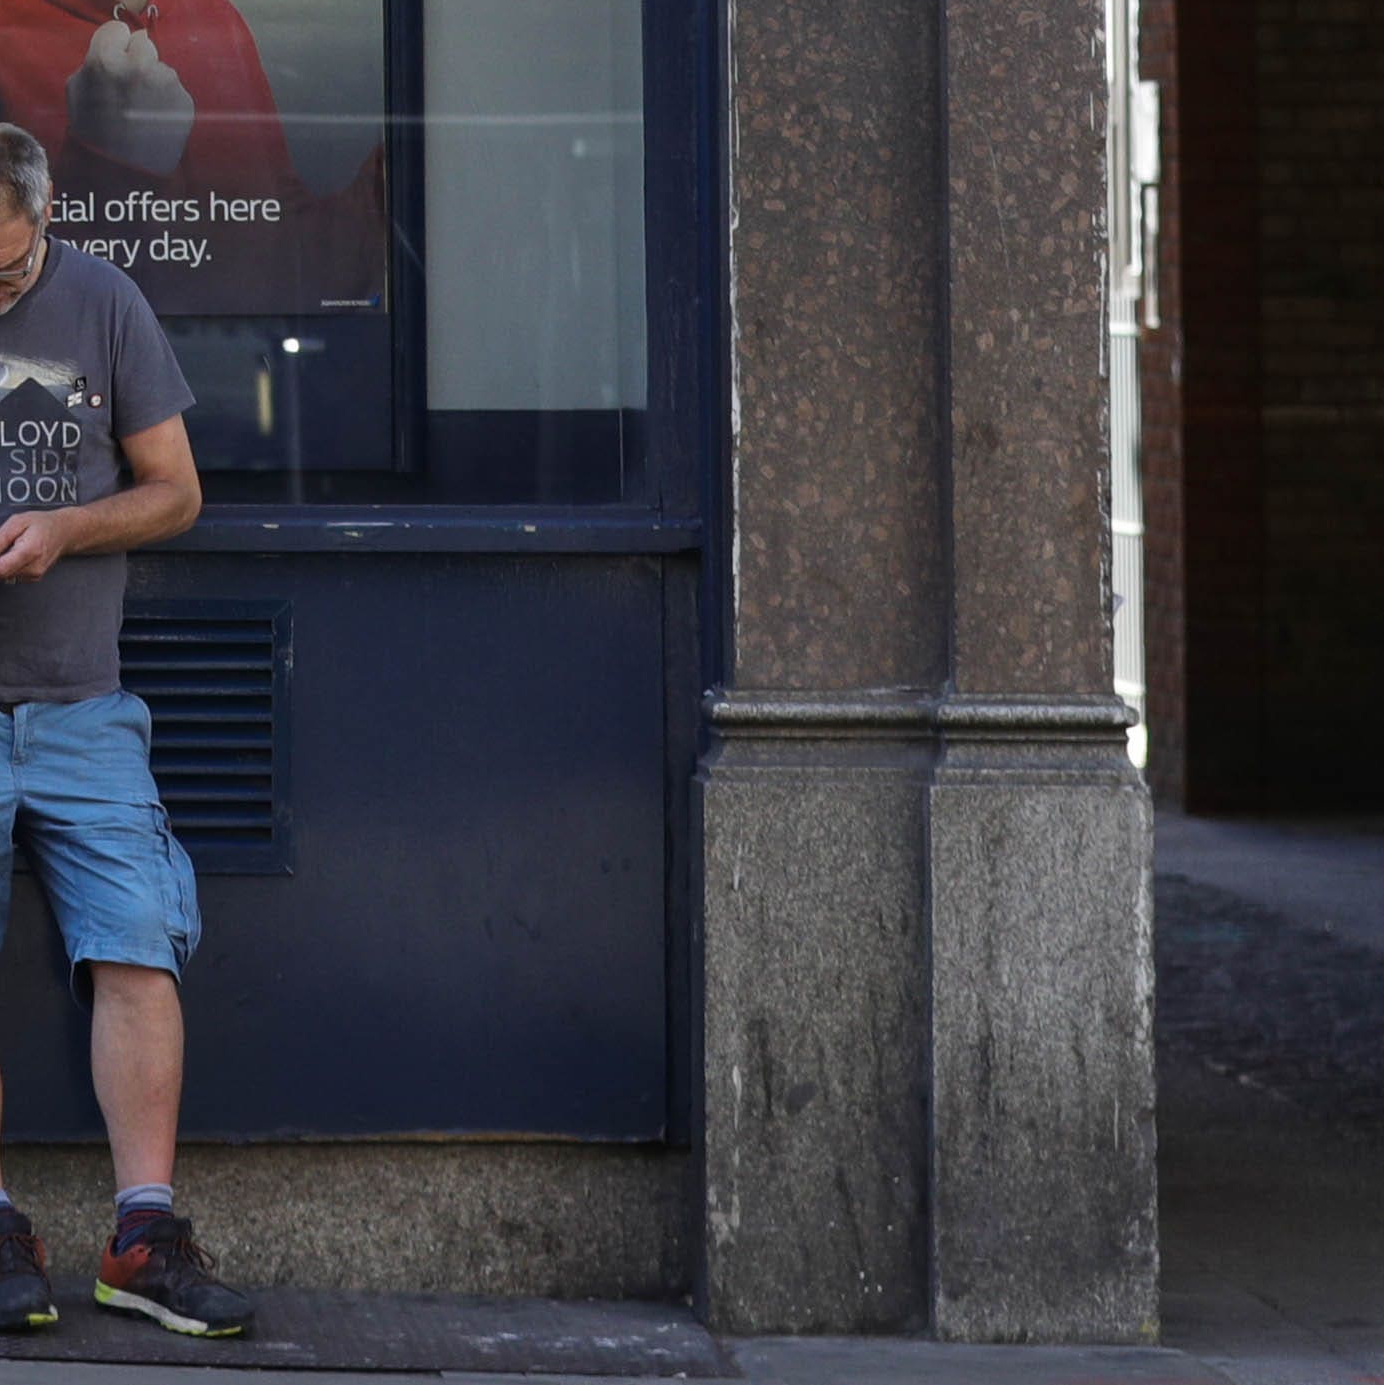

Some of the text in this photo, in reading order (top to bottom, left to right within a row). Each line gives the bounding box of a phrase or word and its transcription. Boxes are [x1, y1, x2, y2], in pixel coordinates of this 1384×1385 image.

[49, 190, 281, 222] cial offers here
[148, 231, 213, 268] day.
[9, 449, 79, 476] SIDE
